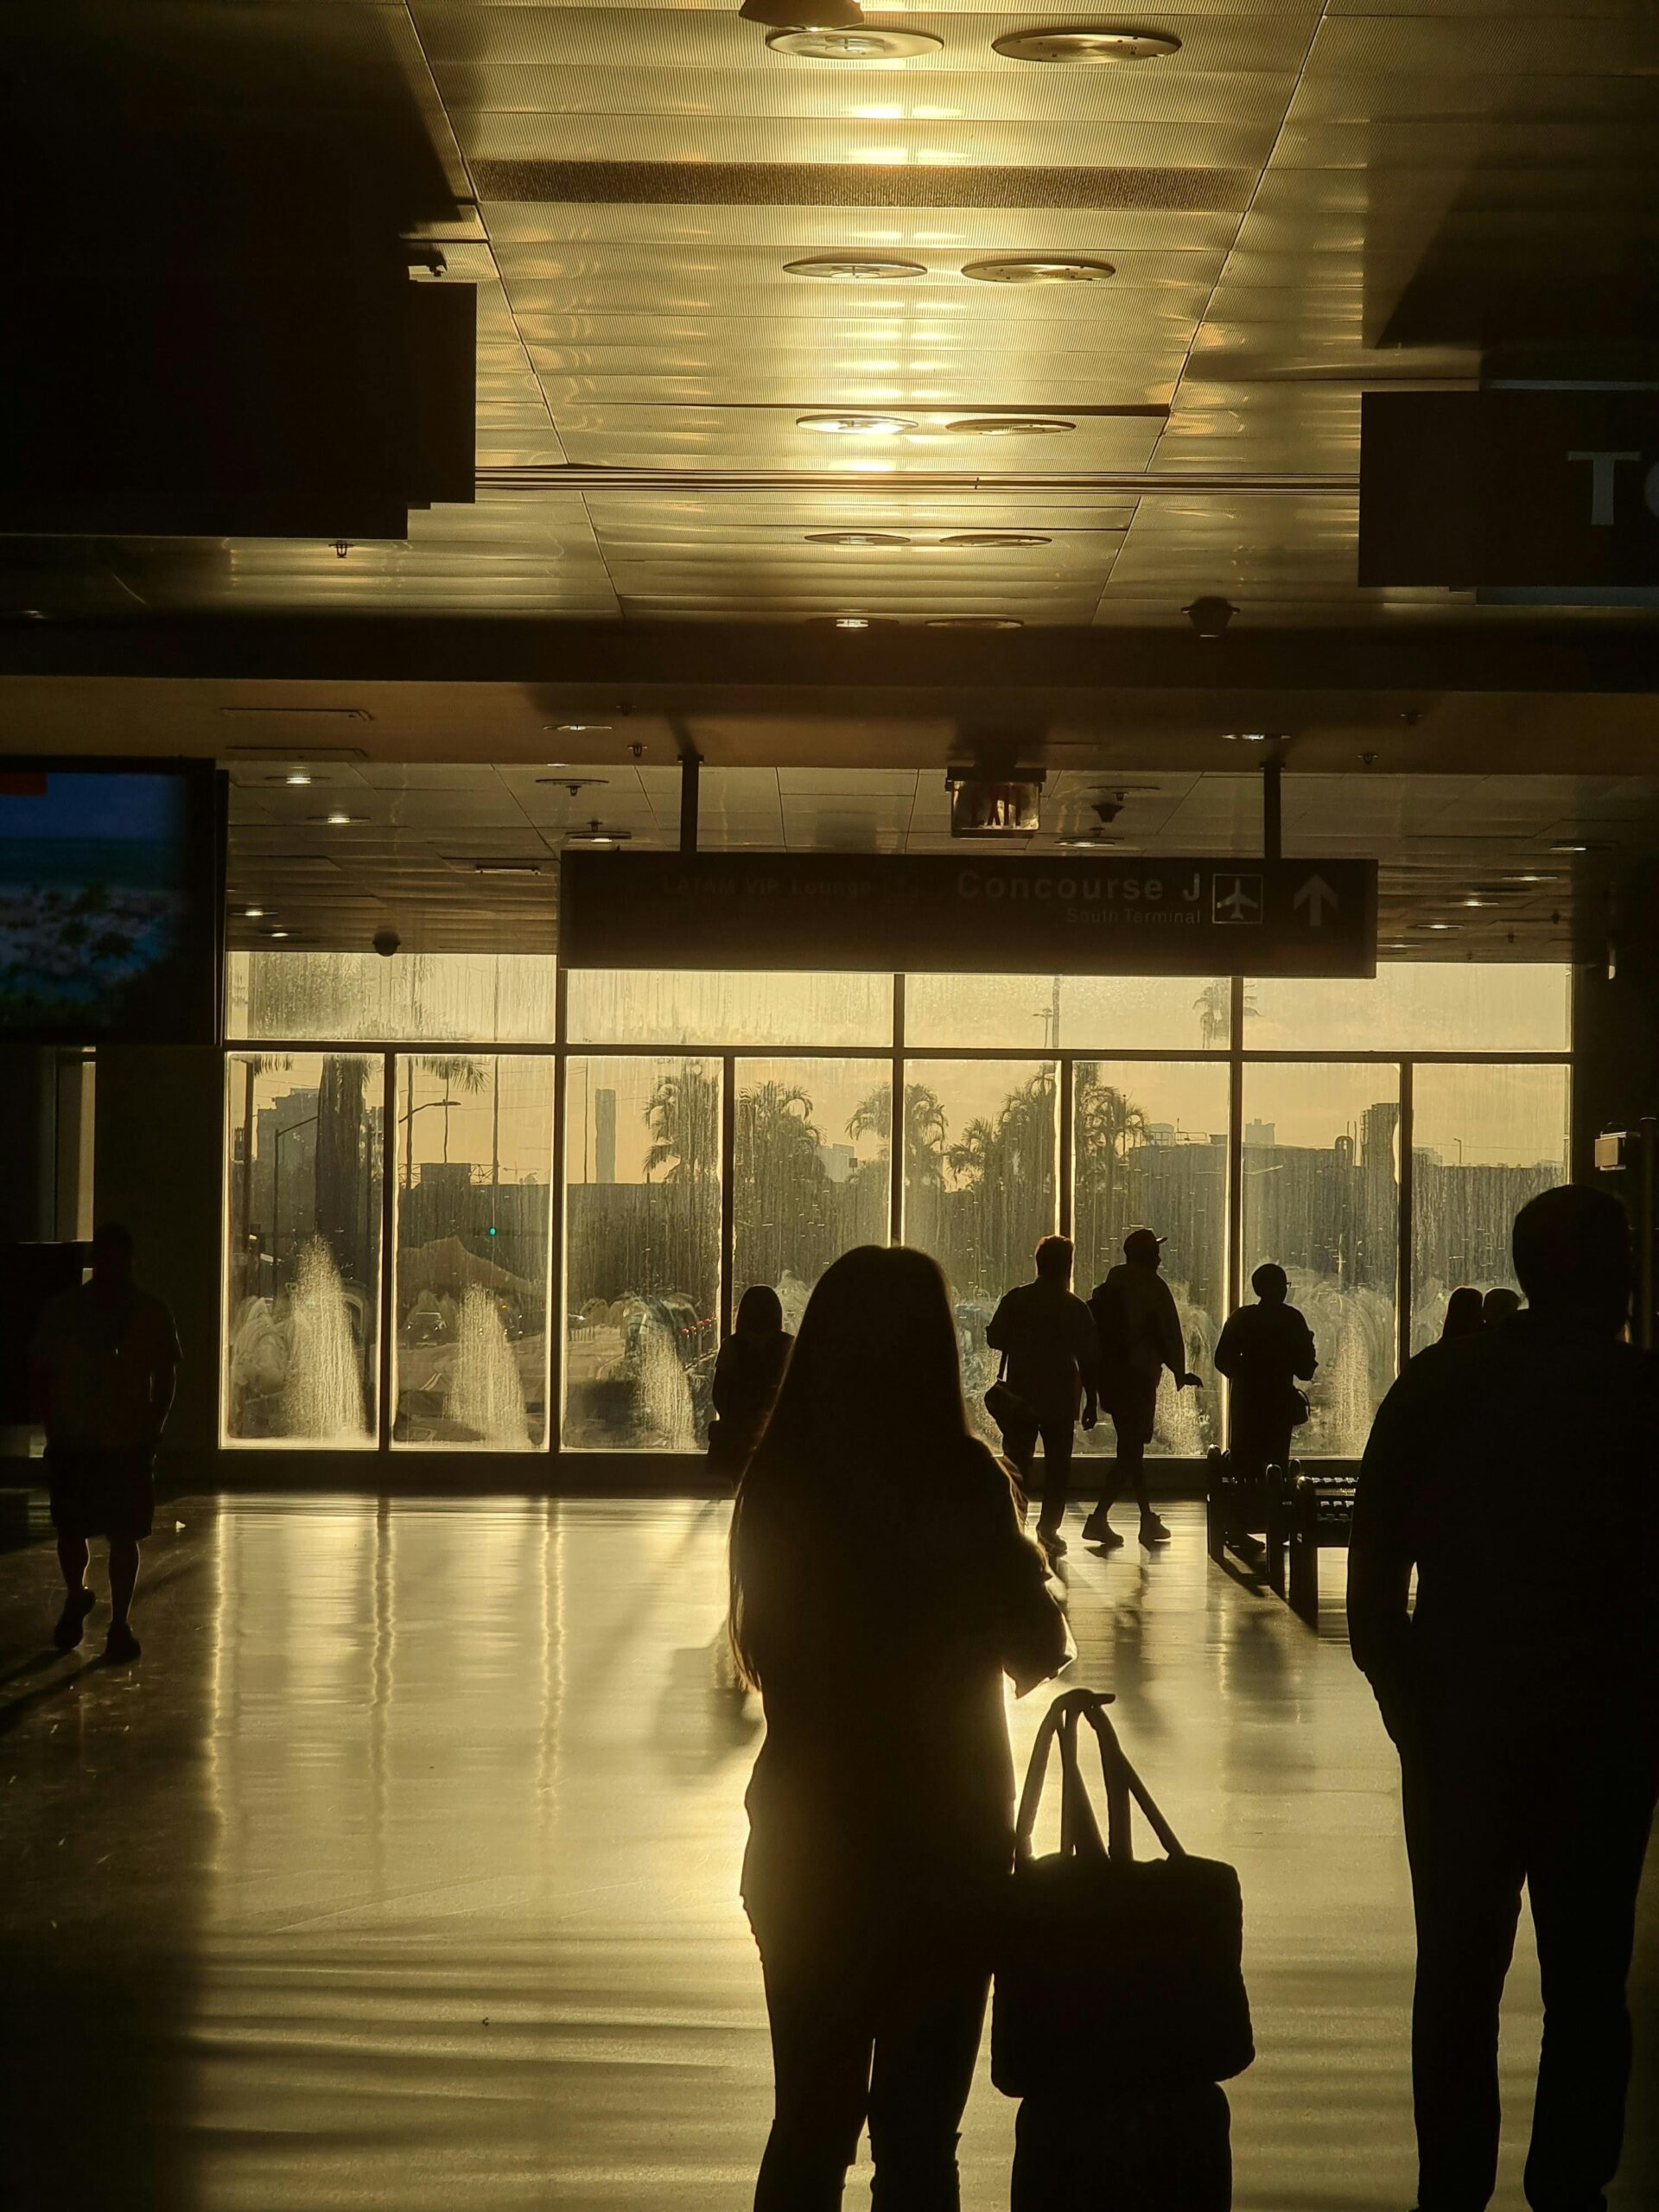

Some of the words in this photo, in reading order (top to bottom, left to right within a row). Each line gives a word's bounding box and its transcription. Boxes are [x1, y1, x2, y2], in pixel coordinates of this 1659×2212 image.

[1567, 451, 1659, 525] T
[957, 869, 1163, 900] Concourse
[1182, 873, 1201, 900] J
[1066, 907, 1120, 924] South
[1122, 907, 1201, 925] Terminal
